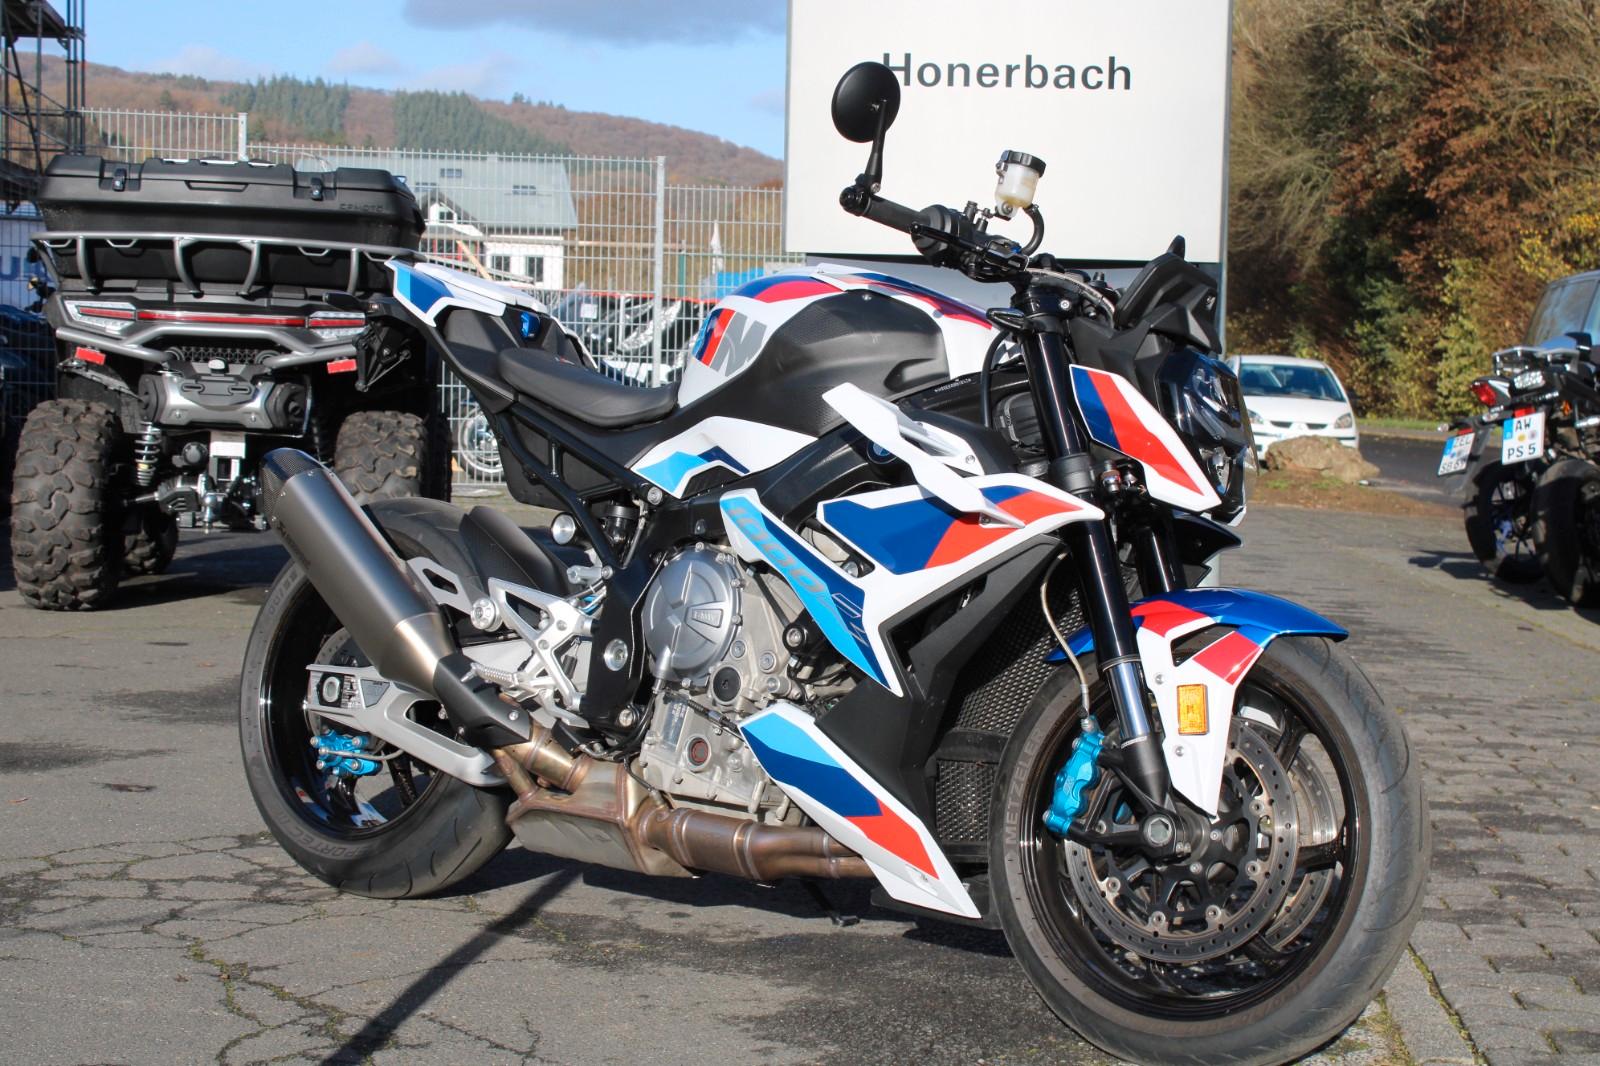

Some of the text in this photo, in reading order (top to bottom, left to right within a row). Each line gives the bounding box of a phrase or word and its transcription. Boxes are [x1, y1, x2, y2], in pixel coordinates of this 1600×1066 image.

[883, 53, 1131, 91] Honerbach
[1515, 418, 1532, 432] AW
[1507, 443, 1536, 459] PS 5
[728, 507, 826, 593] 1000
[1005, 726, 1046, 845] METZELER
